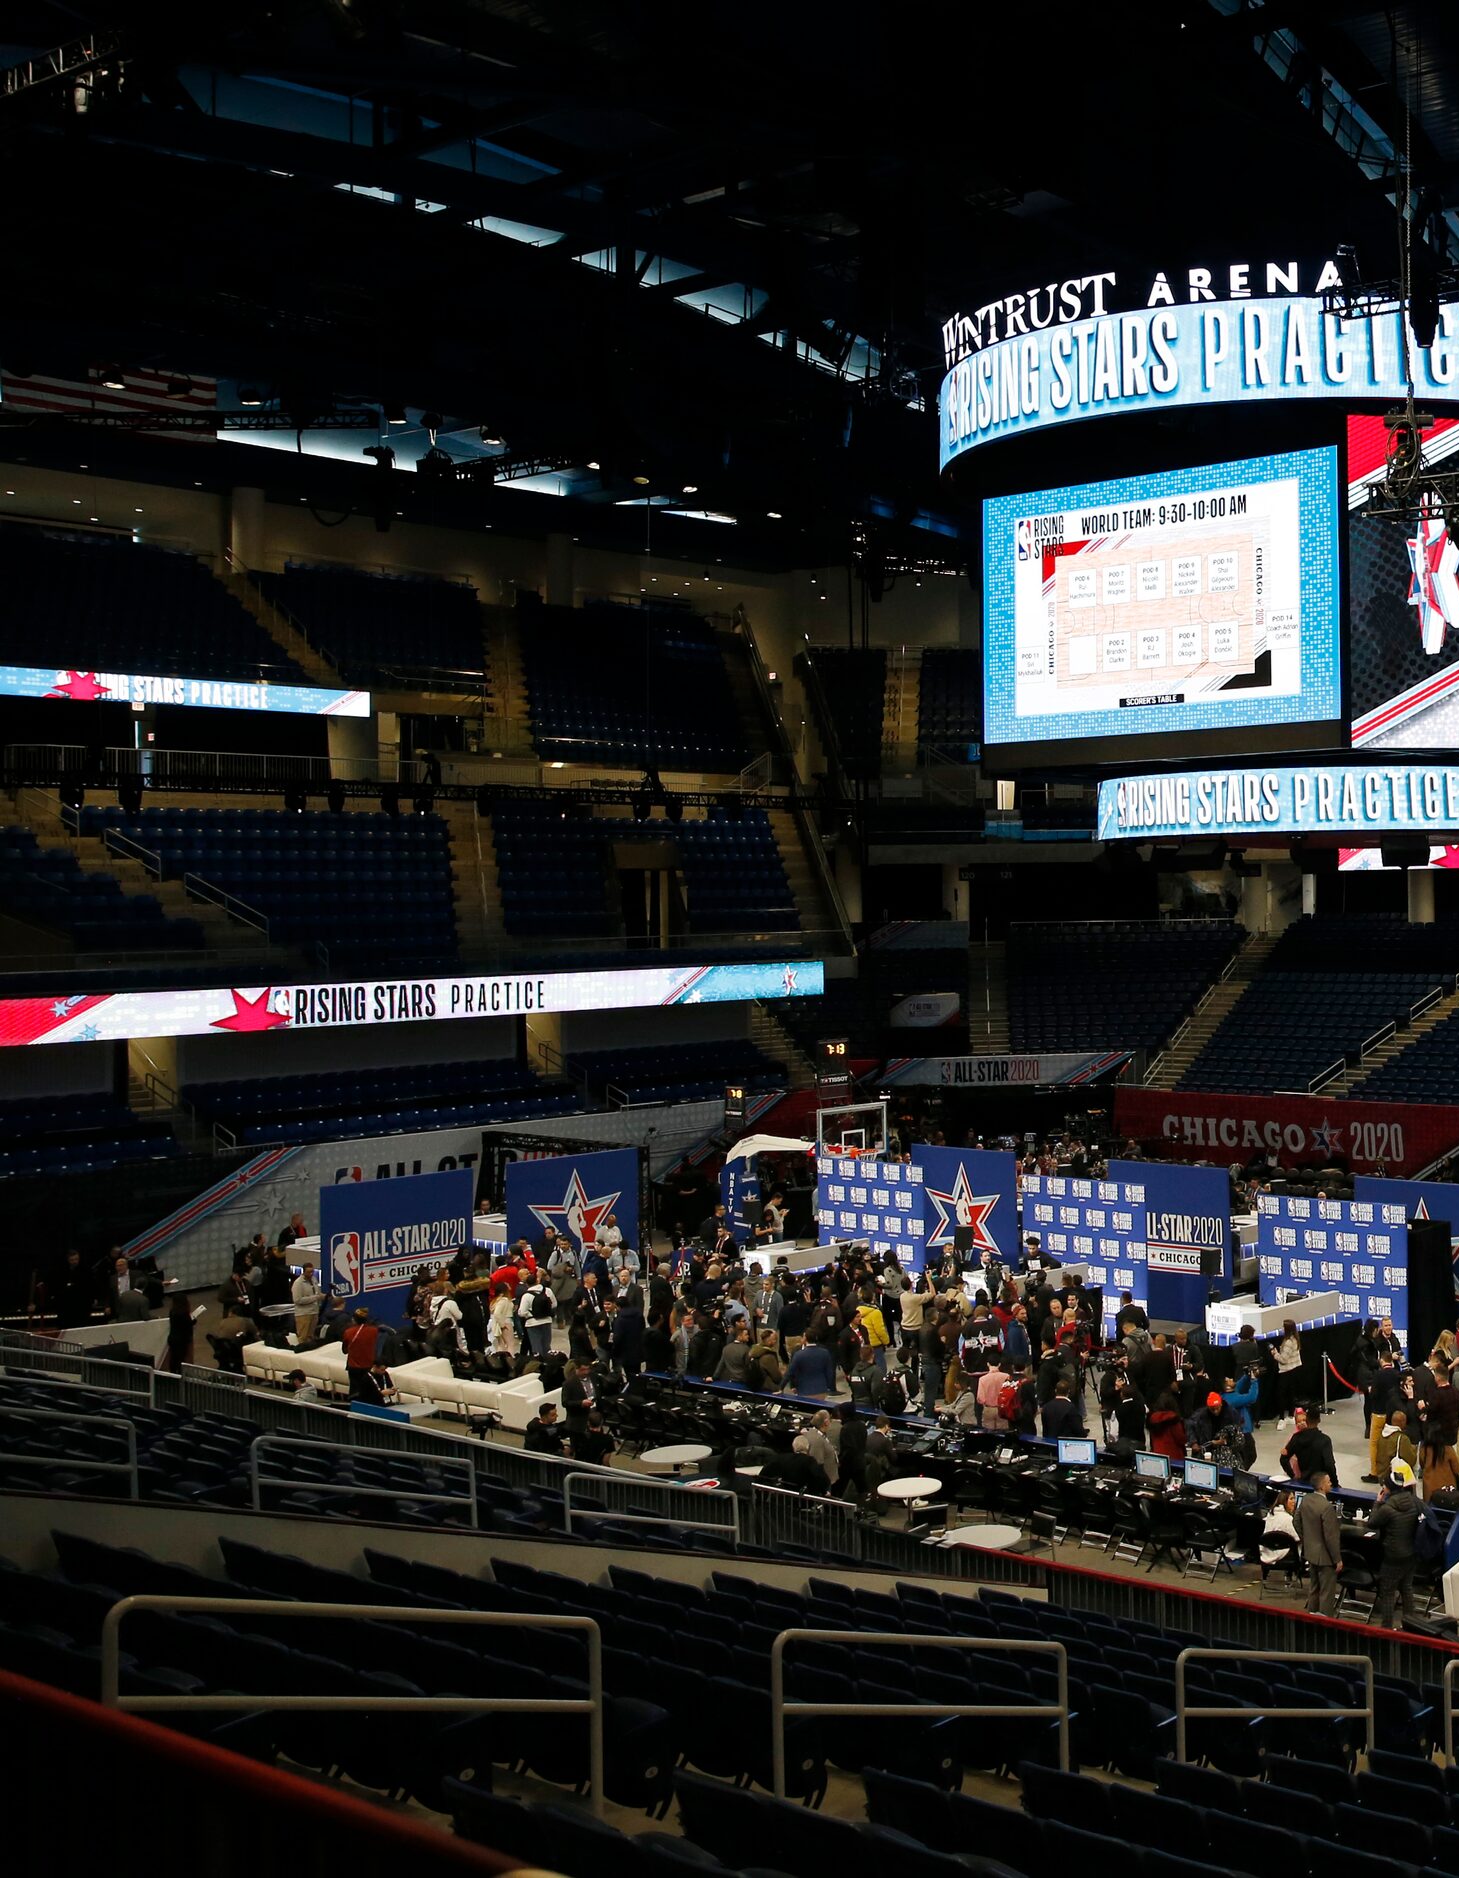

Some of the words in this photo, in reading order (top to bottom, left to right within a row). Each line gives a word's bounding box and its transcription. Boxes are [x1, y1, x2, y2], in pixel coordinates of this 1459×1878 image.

[941, 271, 1116, 370] WINTRUST
[1147, 261, 1345, 307] ARENA
[956, 336, 1040, 441] RISING
[1050, 311, 1179, 409] STARS
[1034, 515, 1064, 537] RISING
[1082, 517, 1119, 535] WORLD
[1123, 508, 1156, 530] TEAM:
[1159, 497, 1226, 525] 9:30-10:00
[1230, 494, 1247, 515] AM
[1034, 536, 1064, 560] STARS
[1255, 547, 1263, 595] CHICAGO
[133, 676, 186, 704] STARS
[191, 681, 269, 709] PRACTICE
[1157, 694, 1178, 704] TABLE
[1129, 777, 1191, 827] RISING
[1197, 773, 1280, 824] STARS
[1293, 772, 1459, 821] PRACTICE
[295, 985, 366, 1024] RISING
[374, 983, 436, 1019] STARS
[451, 980, 545, 1013] PRACTICE
[1162, 1113, 1306, 1154] CHICAGO
[1351, 1121, 1404, 1162] 2020
[728, 1199, 735, 1213] TV
